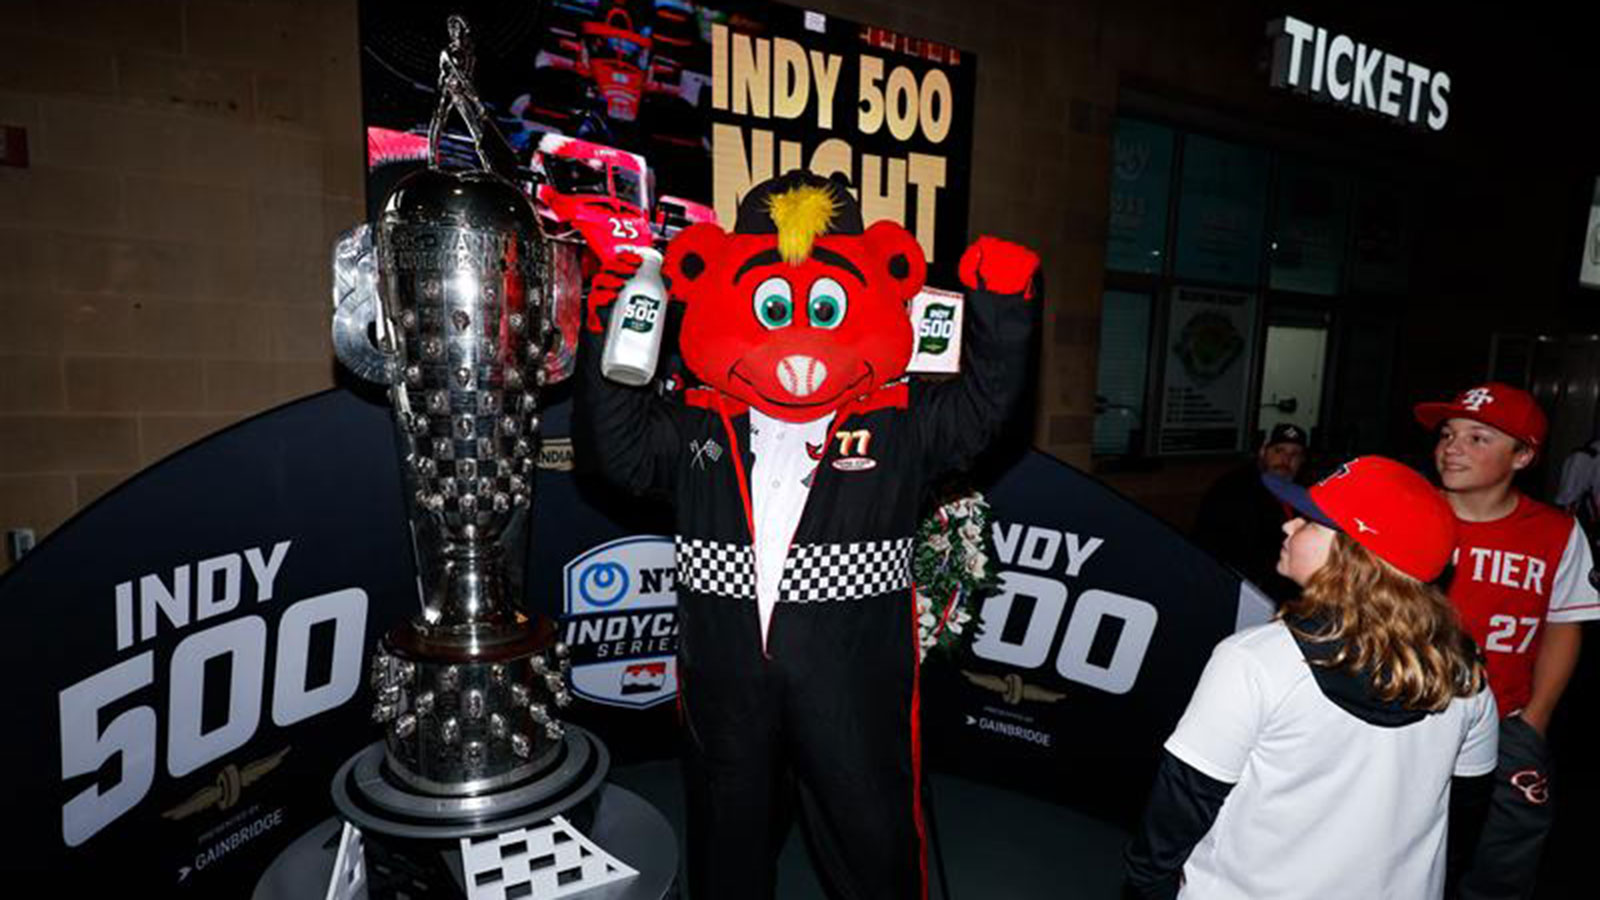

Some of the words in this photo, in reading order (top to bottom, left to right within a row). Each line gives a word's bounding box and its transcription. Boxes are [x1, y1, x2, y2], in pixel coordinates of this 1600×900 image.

[711, 23, 843, 130] INDY
[857, 53, 953, 143] 500
[1284, 16, 1450, 130] TICKETS
[608, 217, 639, 240] 25
[624, 304, 658, 323] 500
[919, 318, 954, 339] 500
[541, 449, 575, 464] INDIA
[835, 430, 872, 457] 77
[991, 520, 1105, 577] NDY
[639, 567, 678, 594] NT
[1469, 547, 1547, 595] TIER
[115, 540, 292, 651] INDY
[565, 612, 679, 646] INDYC
[596, 637, 679, 658] SERIE
[971, 570, 1159, 695] 00
[1485, 614, 1541, 654] 27
[58, 587, 369, 848] 500
[978, 716, 1051, 747] GAINBRIDGE
[194, 808, 284, 871] GAINBRIDGE
